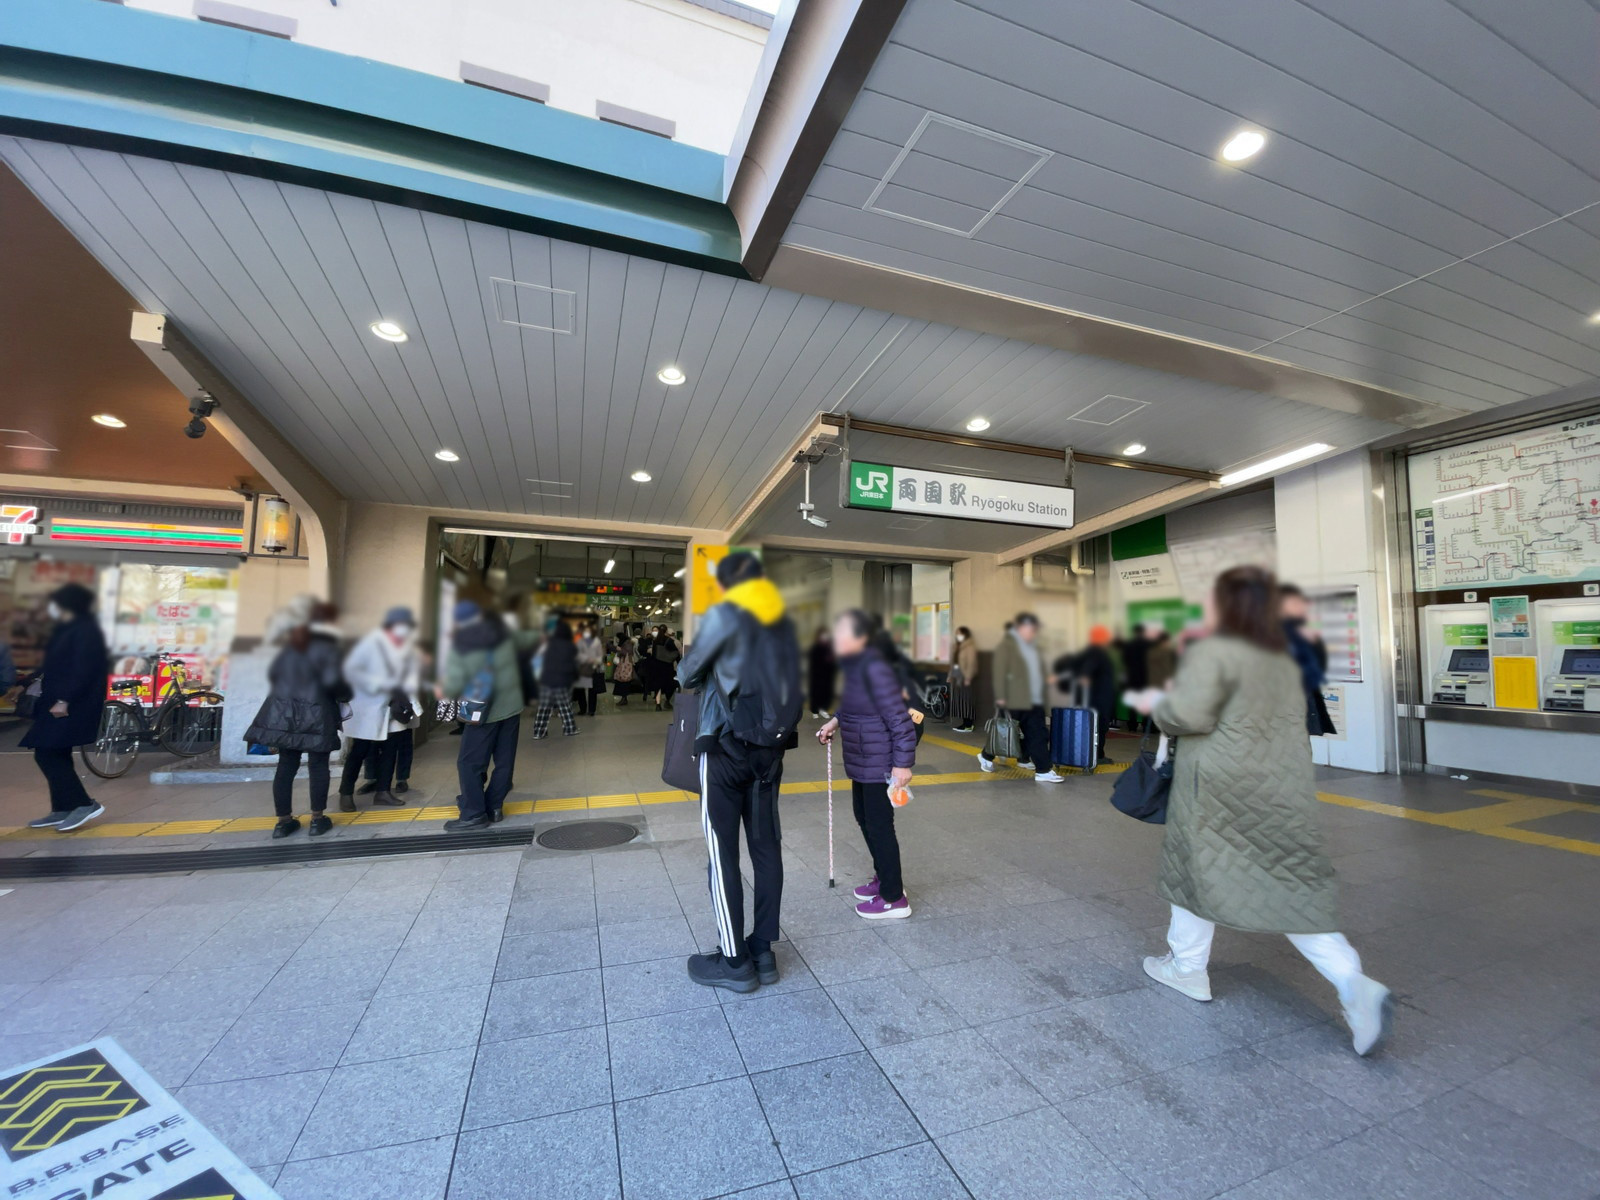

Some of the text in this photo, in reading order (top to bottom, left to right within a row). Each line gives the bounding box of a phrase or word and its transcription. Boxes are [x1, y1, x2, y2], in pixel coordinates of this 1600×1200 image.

[856, 471, 888, 493] JR
[898, 478, 967, 507] 両国駅
[1027, 502, 1067, 517] Station
[2, 505, 37, 544] 7
[156, 605, 190, 618] たばこ
[8, 1114, 186, 1194] B.B.BASE
